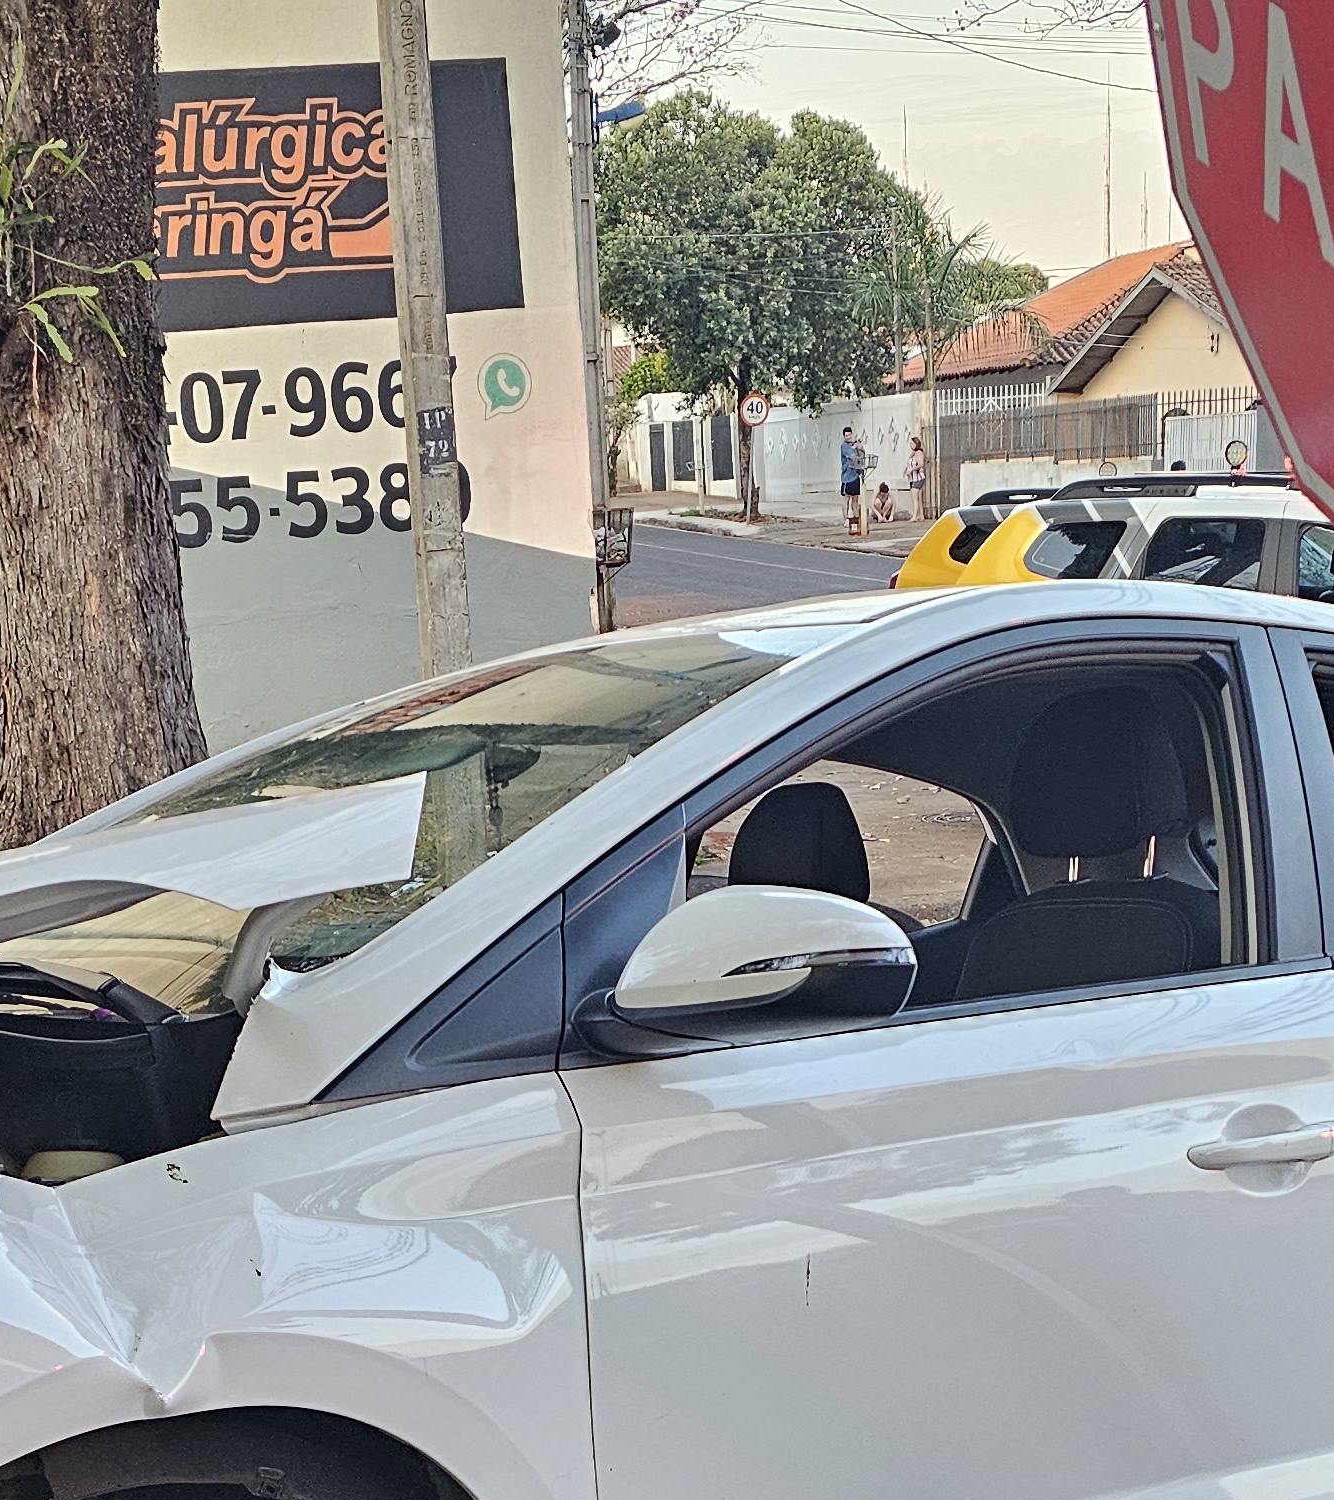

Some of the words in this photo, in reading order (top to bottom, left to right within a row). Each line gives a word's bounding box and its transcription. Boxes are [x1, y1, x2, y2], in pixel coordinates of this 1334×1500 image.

[154, 106, 387, 184] alúrgica
[154, 188, 323, 268] ringá
[747, 401, 763, 414] 40
